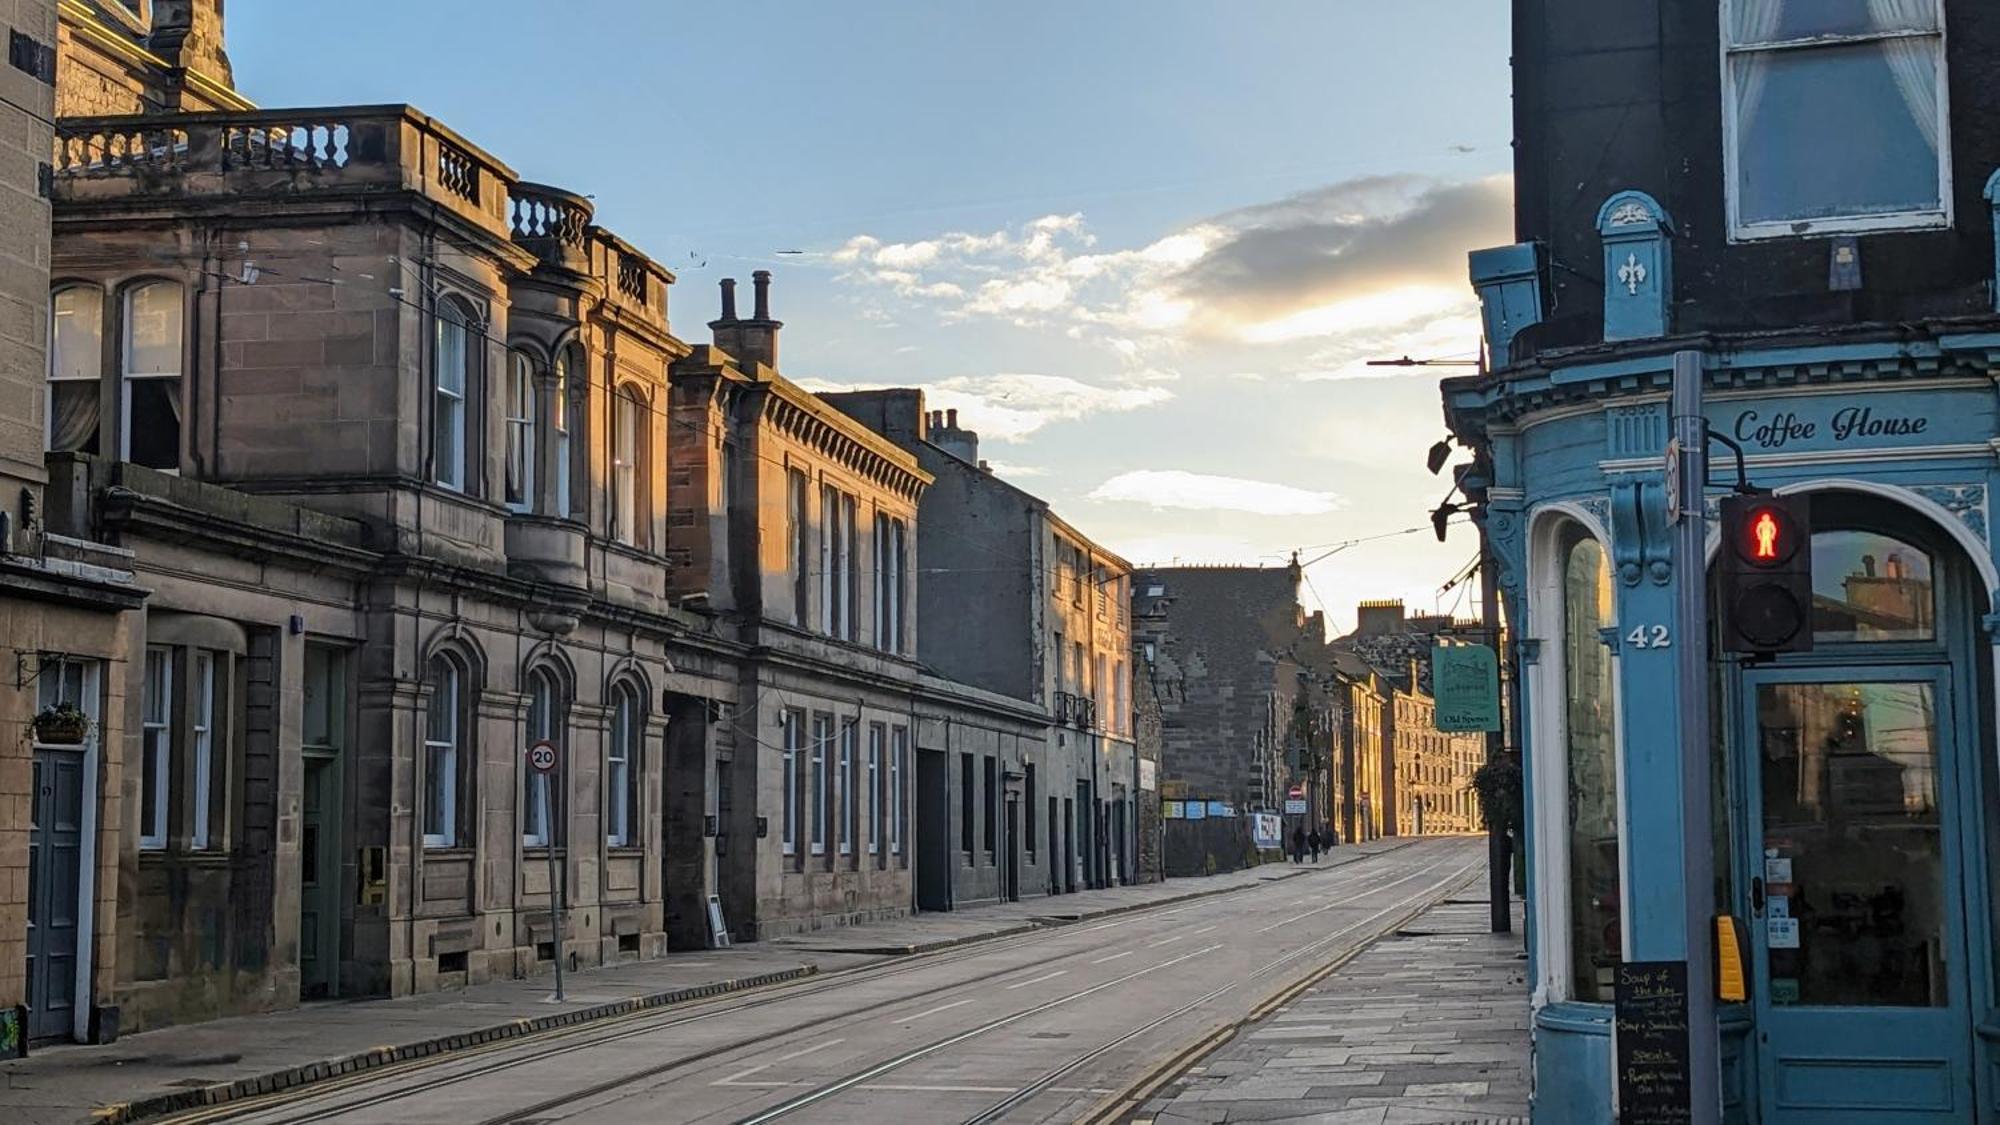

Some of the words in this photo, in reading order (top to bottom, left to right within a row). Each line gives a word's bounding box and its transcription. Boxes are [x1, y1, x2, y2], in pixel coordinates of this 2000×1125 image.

[1734, 410, 1816, 448] Coffee
[1831, 407, 1927, 441] House
[1626, 624, 1670, 648] 42
[534, 751, 553, 763] 20
[1621, 967, 1650, 986] Soup
[1656, 969, 1669, 982] of
